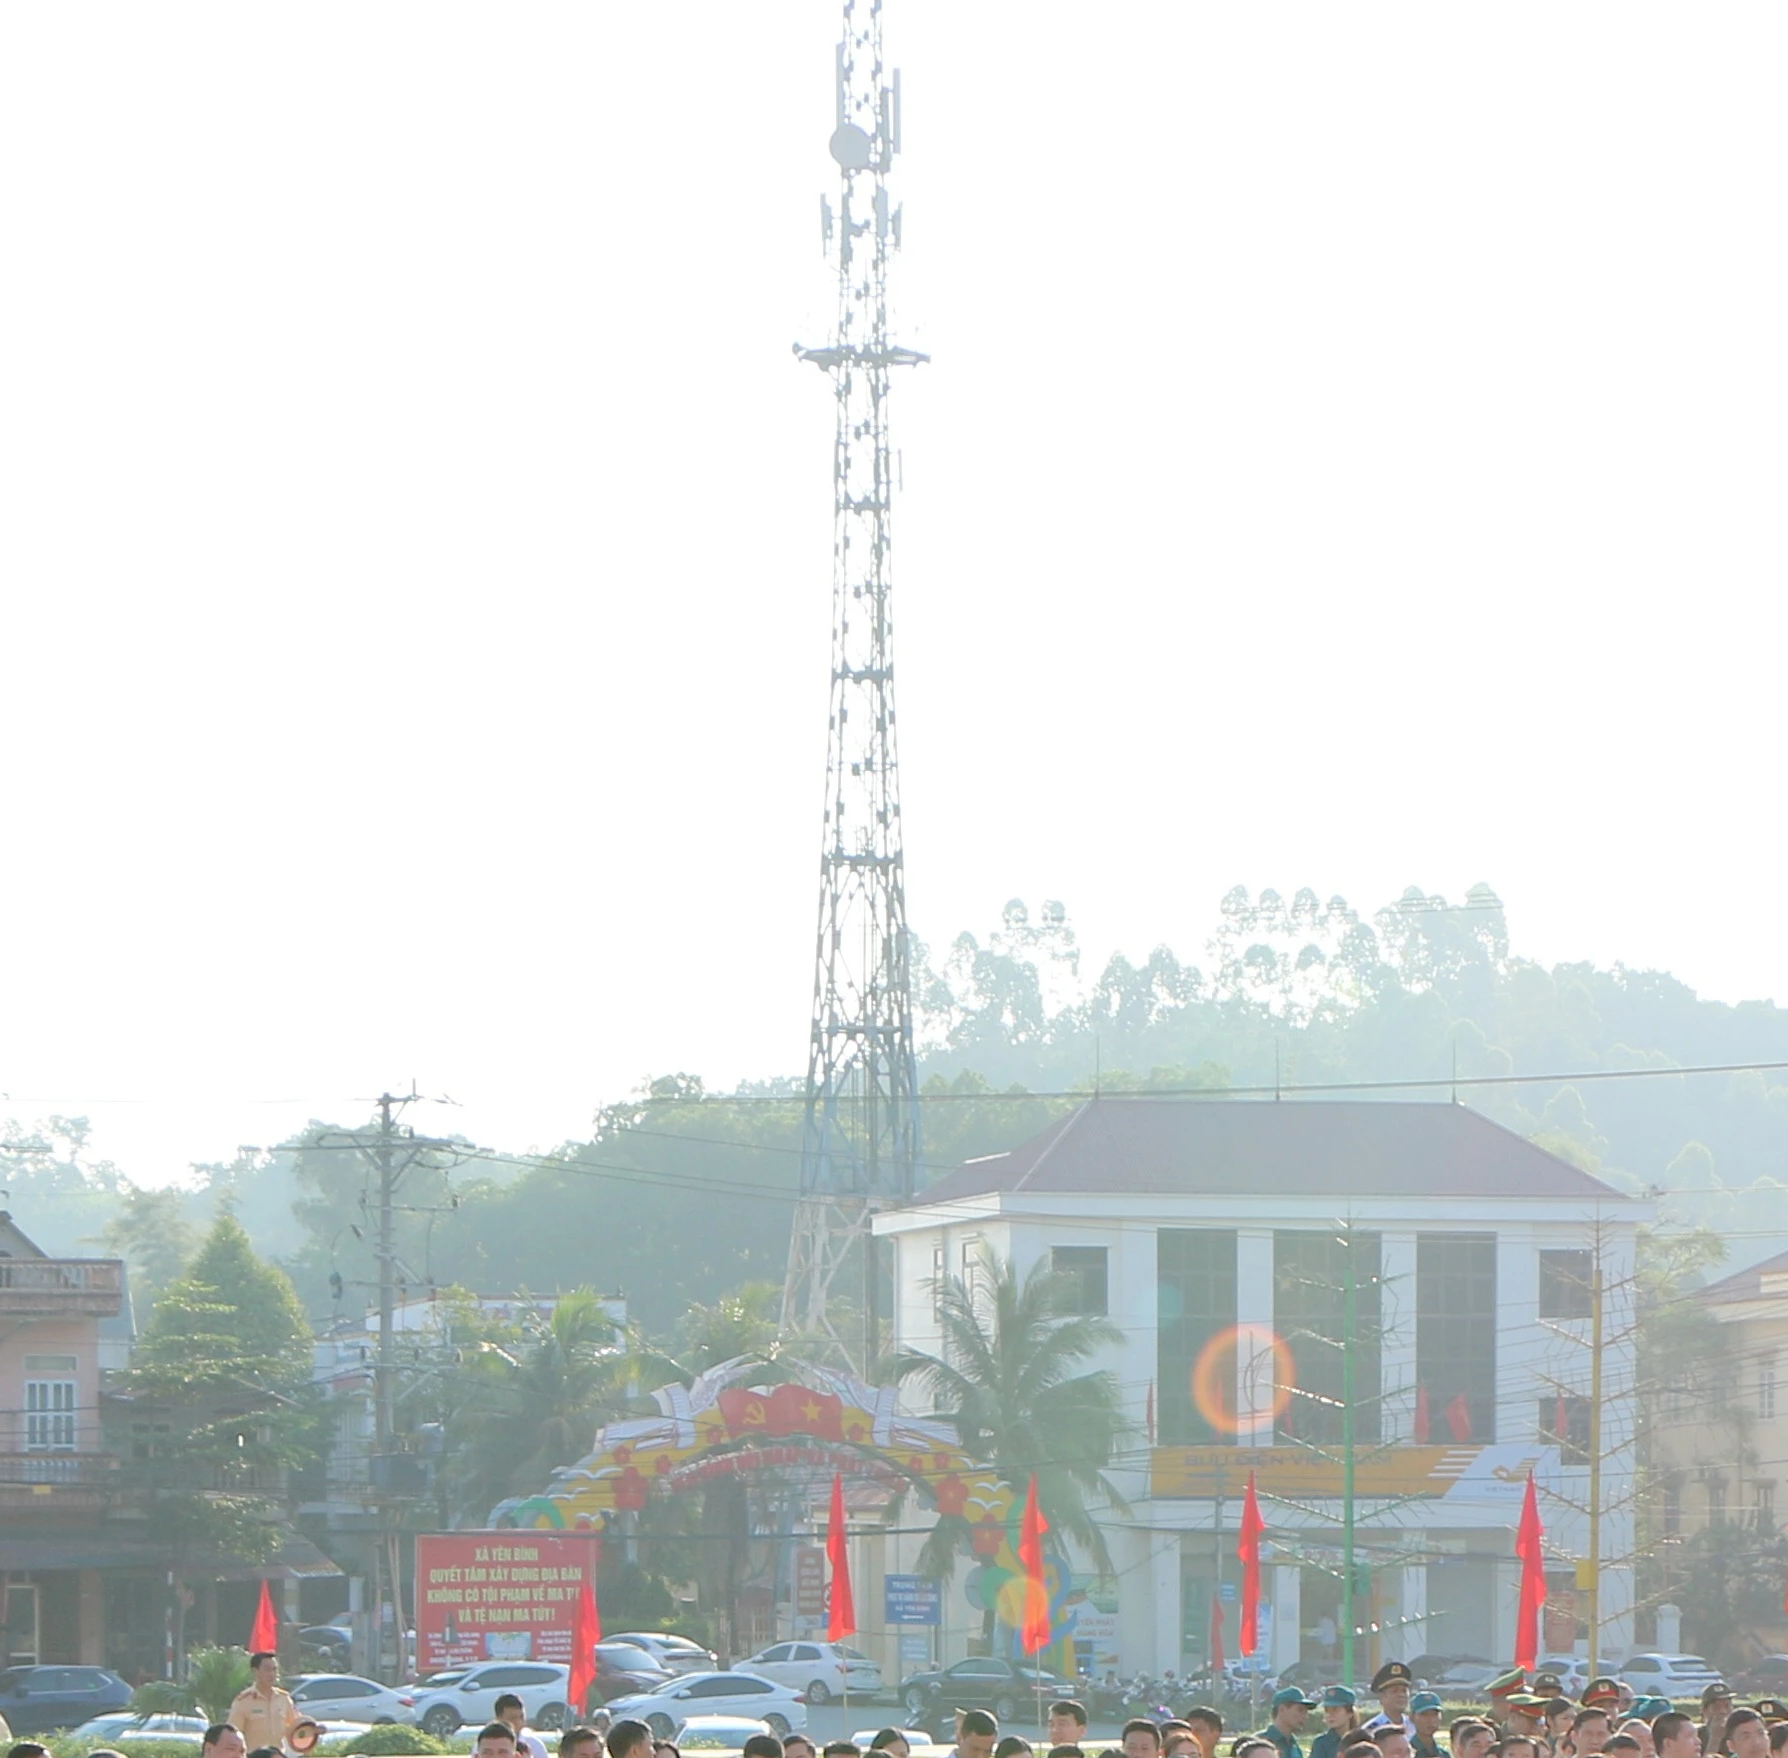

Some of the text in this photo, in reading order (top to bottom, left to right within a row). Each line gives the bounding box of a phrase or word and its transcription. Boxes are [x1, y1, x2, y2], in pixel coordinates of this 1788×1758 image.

[492, 1546, 512, 1561] YÊN
[514, 1544, 539, 1561] BÌNH
[429, 1563, 582, 1584] QUYẾT TÂM XÂY DỰNG ĐỊA BÀN
[427, 1586, 463, 1603] KHÔNG
[464, 1585, 479, 1602] CÓ
[481, 1586, 498, 1606] TỘI
[500, 1586, 530, 1605] PHẠM
[547, 1587, 564, 1601] MA
[458, 1605, 472, 1623] VÀ
[489, 1607, 511, 1625] NẠN
[513, 1607, 529, 1622] MA
